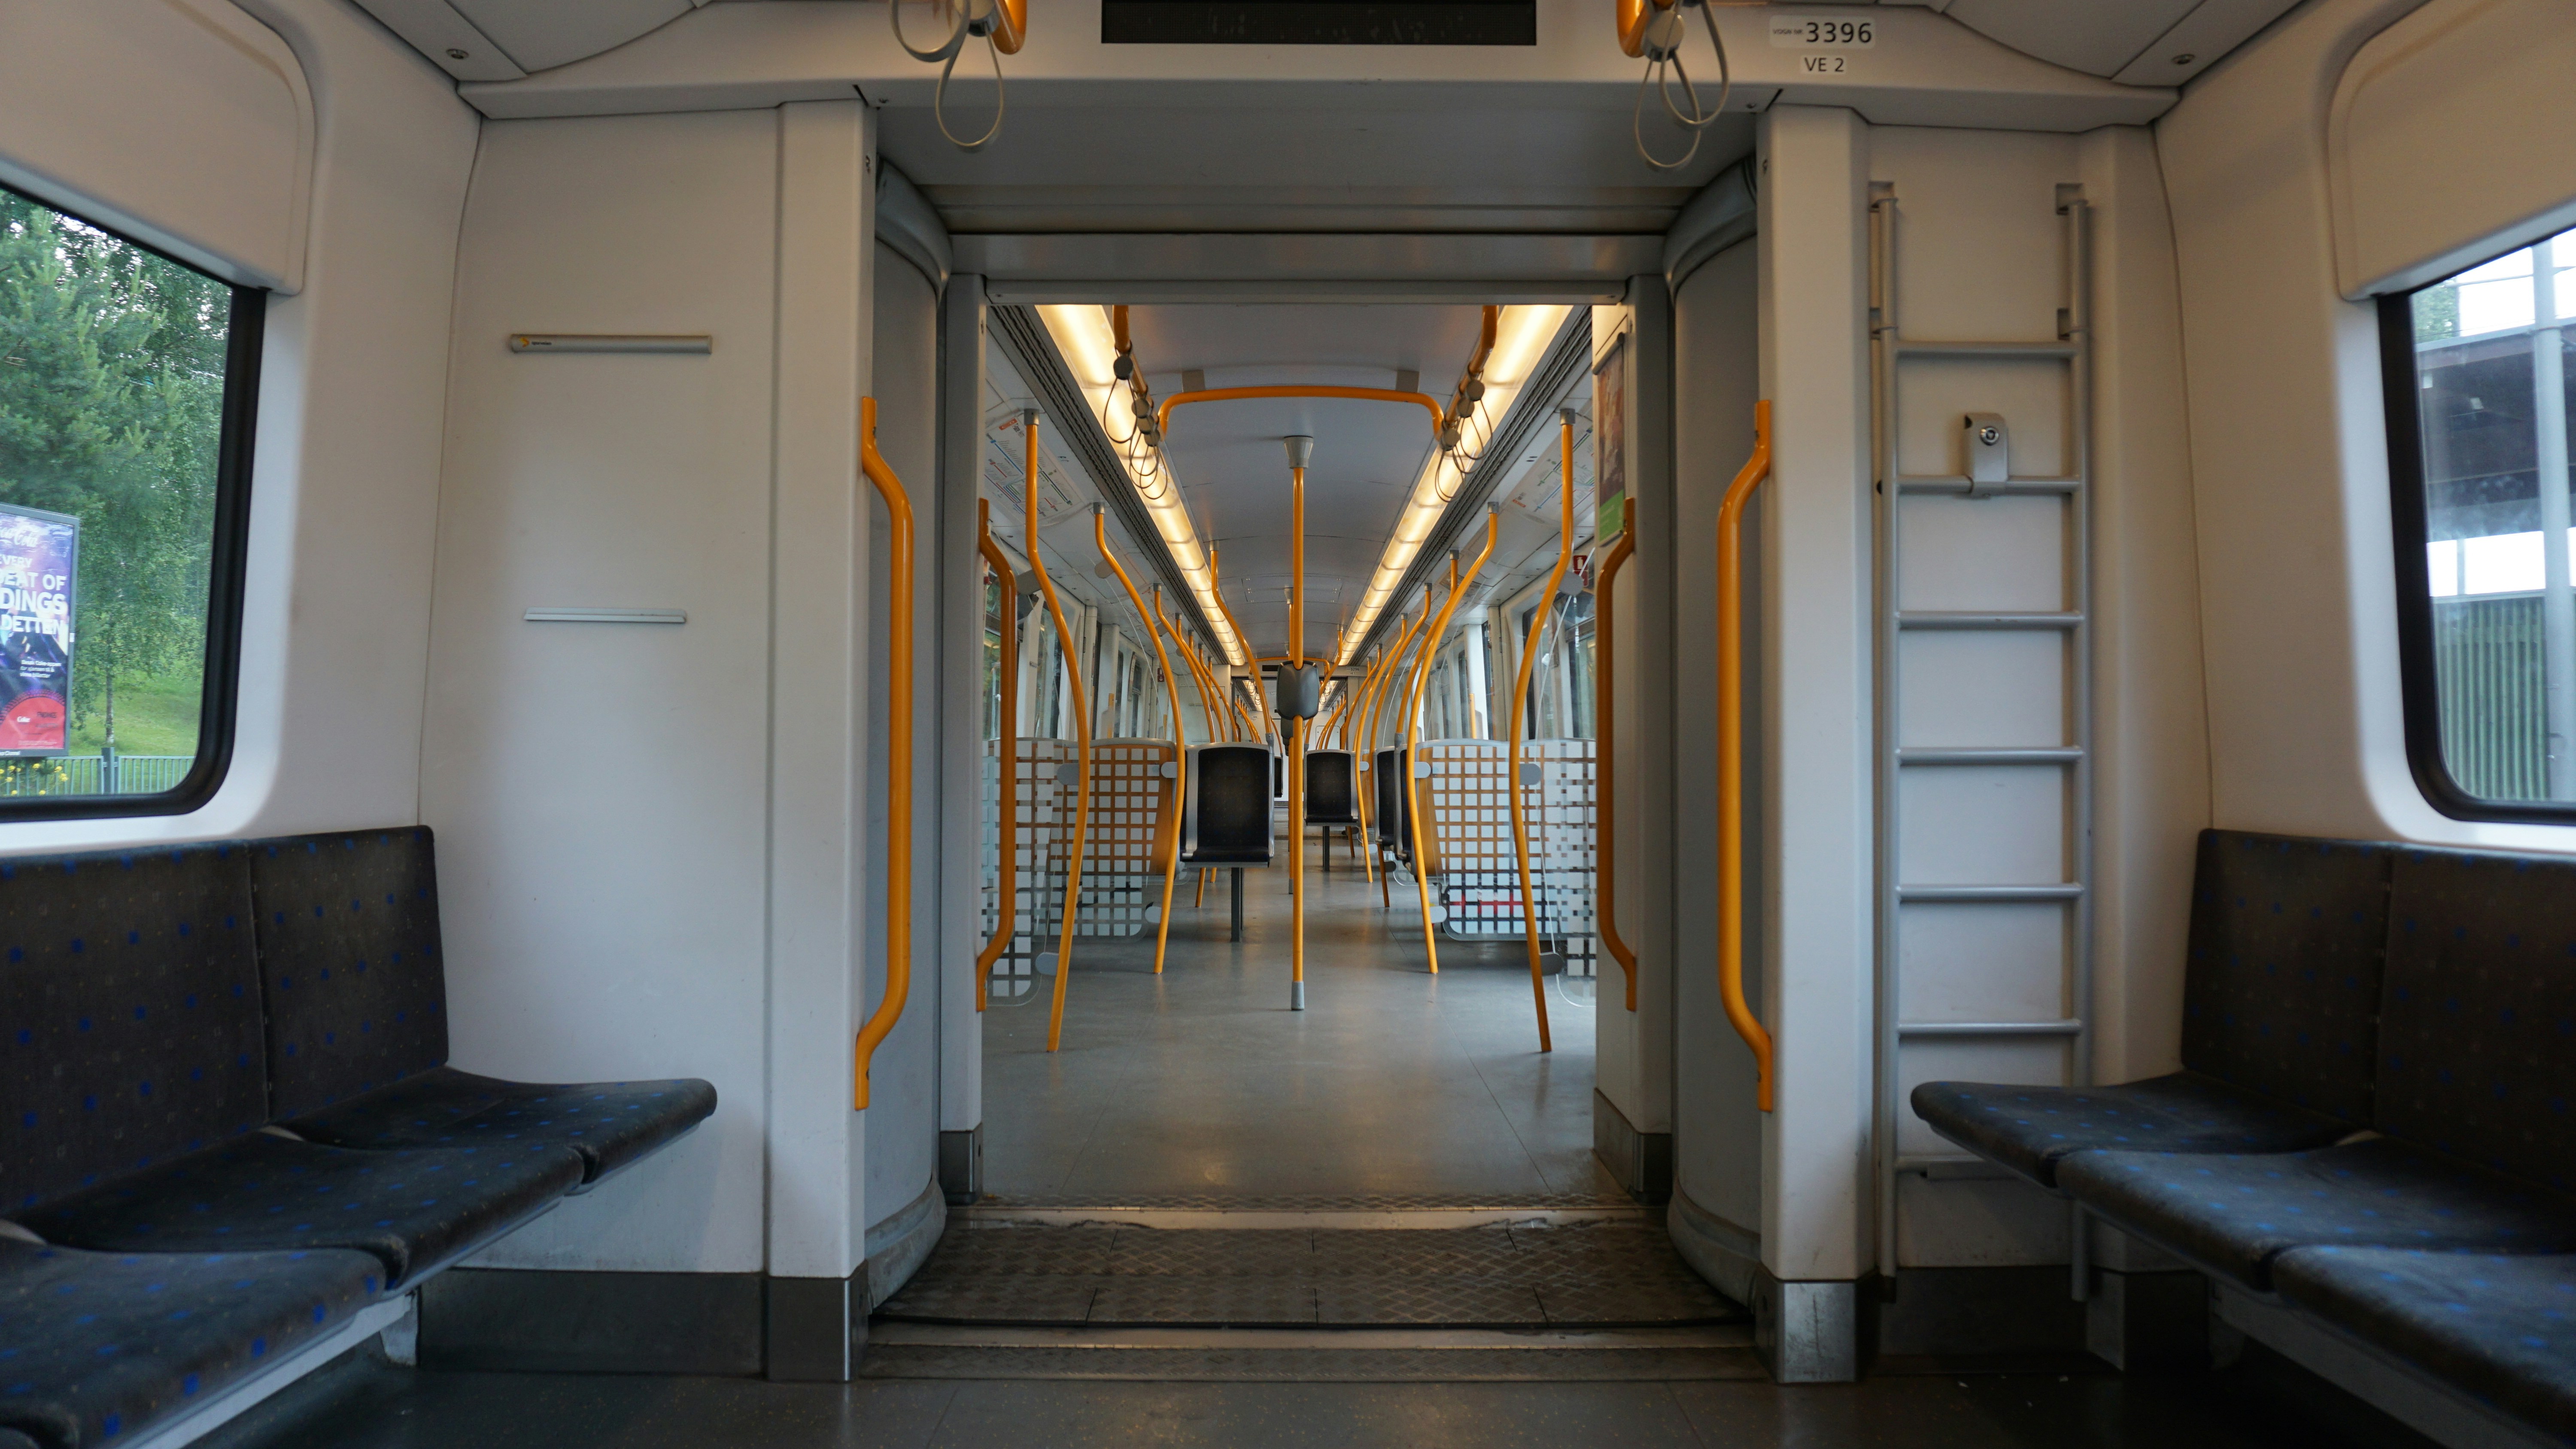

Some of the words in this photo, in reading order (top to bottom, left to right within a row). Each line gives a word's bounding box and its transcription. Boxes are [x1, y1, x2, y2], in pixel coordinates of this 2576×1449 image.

[1806, 22, 1872, 43] 3396
[1804, 57, 1827, 72] VE
[1835, 58, 1844, 72] 2
[43, 574, 67, 591] OF
